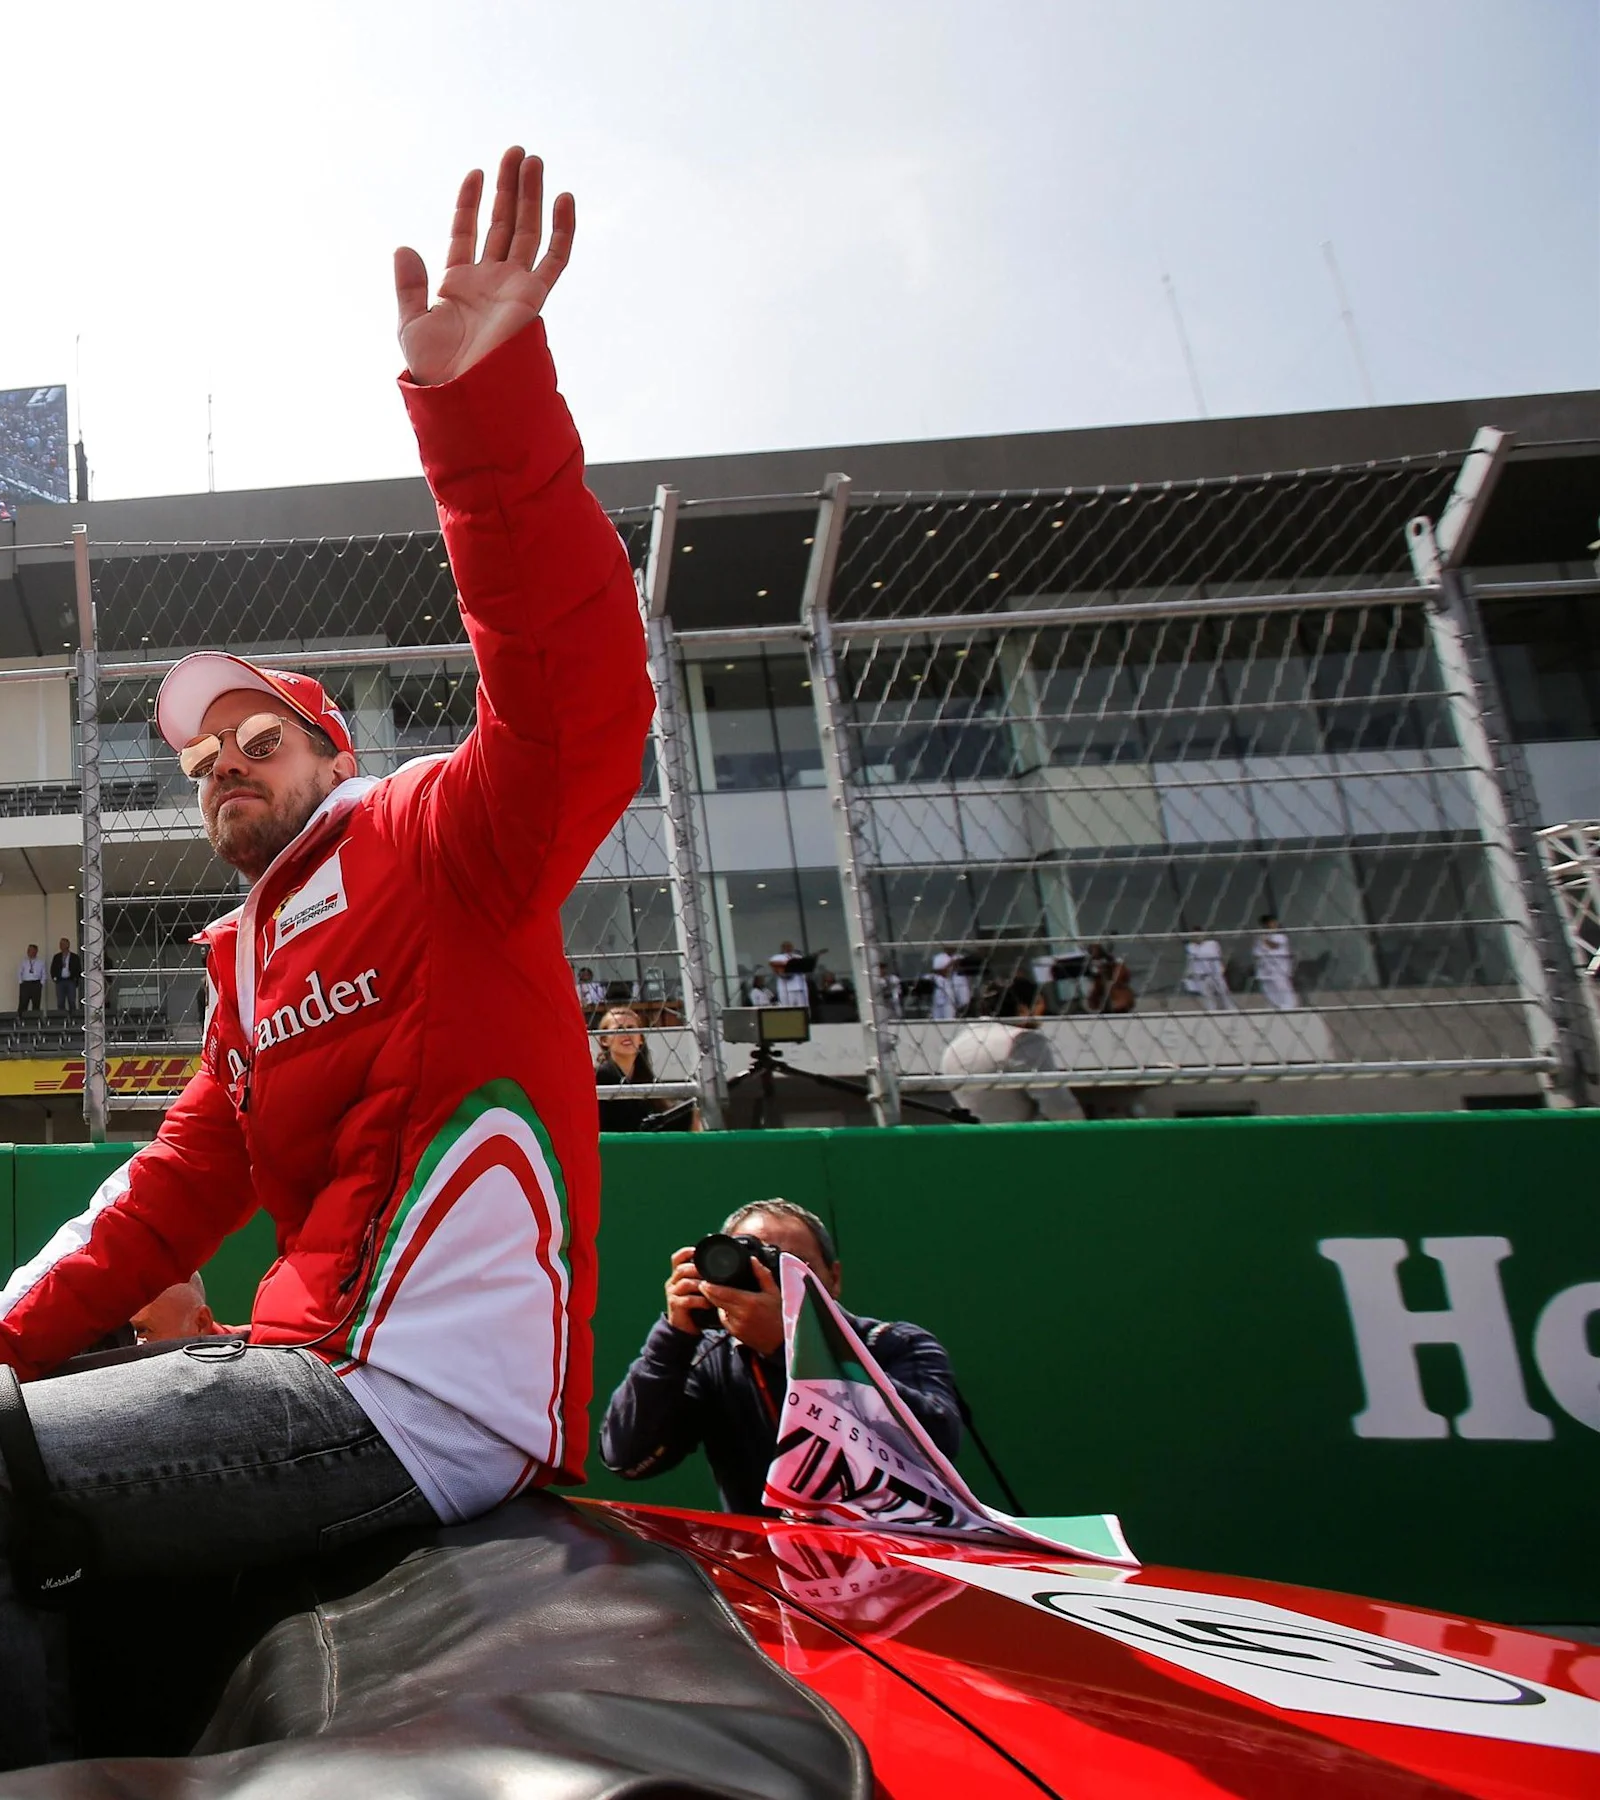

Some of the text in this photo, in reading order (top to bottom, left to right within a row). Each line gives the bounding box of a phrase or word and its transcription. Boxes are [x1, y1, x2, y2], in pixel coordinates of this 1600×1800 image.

[280, 899, 325, 930] SCUDERIA
[295, 900, 338, 928] FERRARI
[41, 1568, 82, 1590] Marshall
[1093, 1604, 1442, 1678] 5
